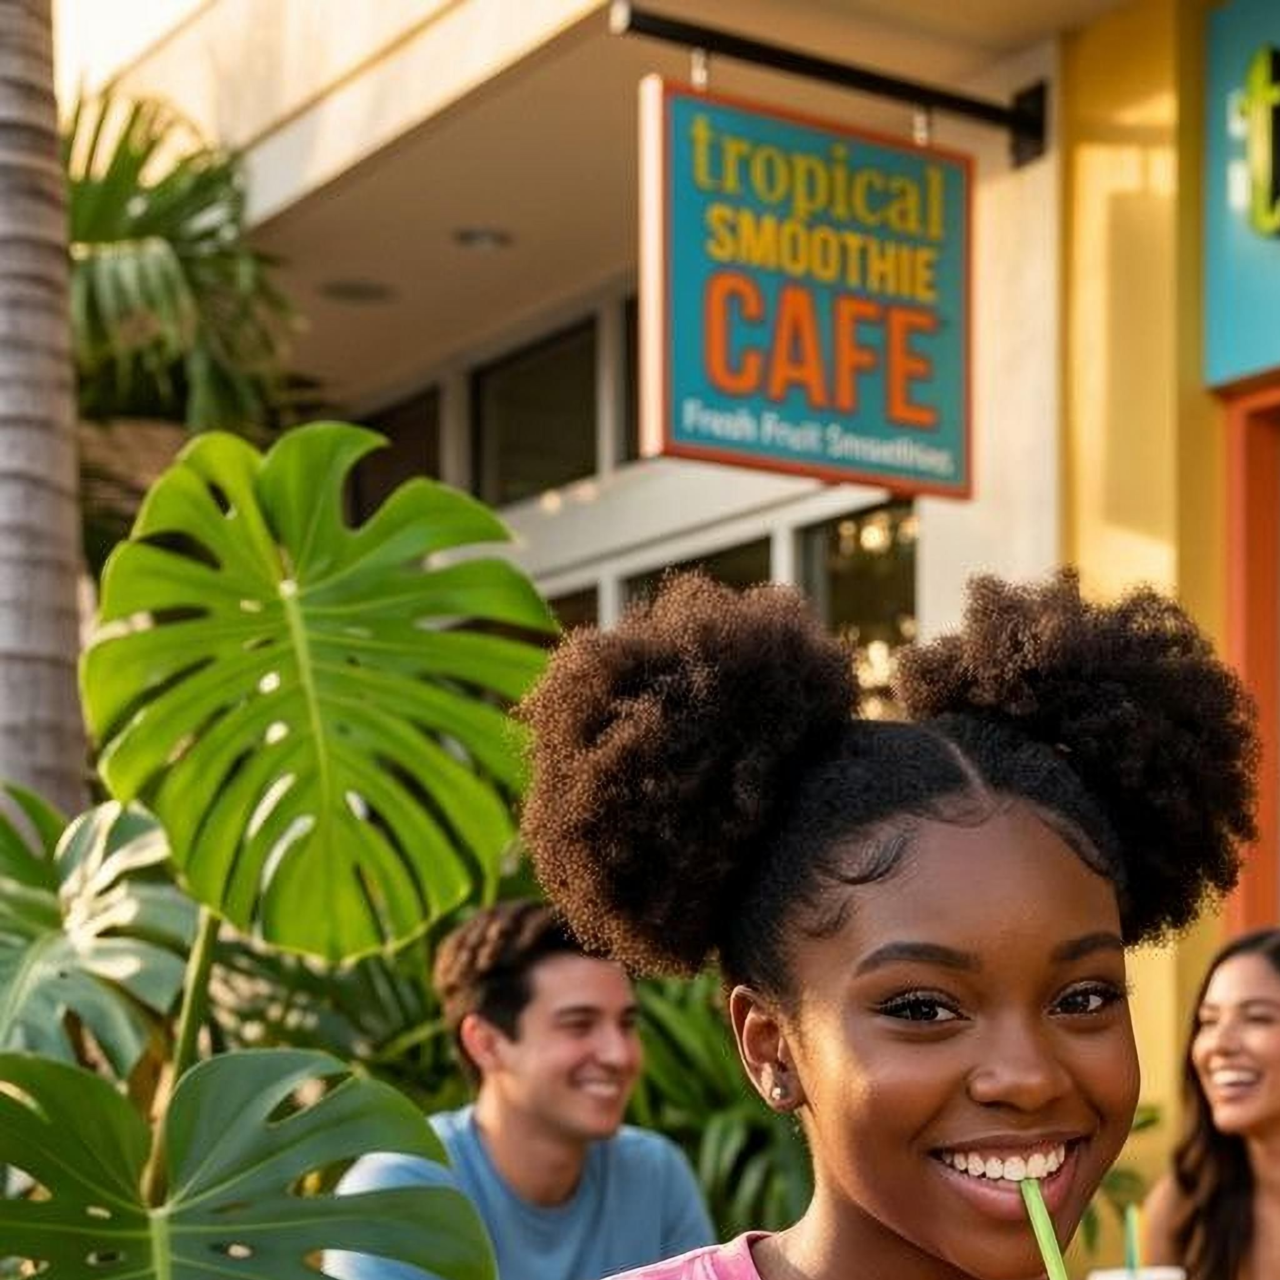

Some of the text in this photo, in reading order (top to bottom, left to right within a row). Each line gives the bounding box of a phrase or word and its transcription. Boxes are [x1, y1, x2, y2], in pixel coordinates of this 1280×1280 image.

[692, 115, 942, 238] tropical
[708, 205, 936, 299] SMOOTHIE
[705, 273, 937, 425] CAFE
